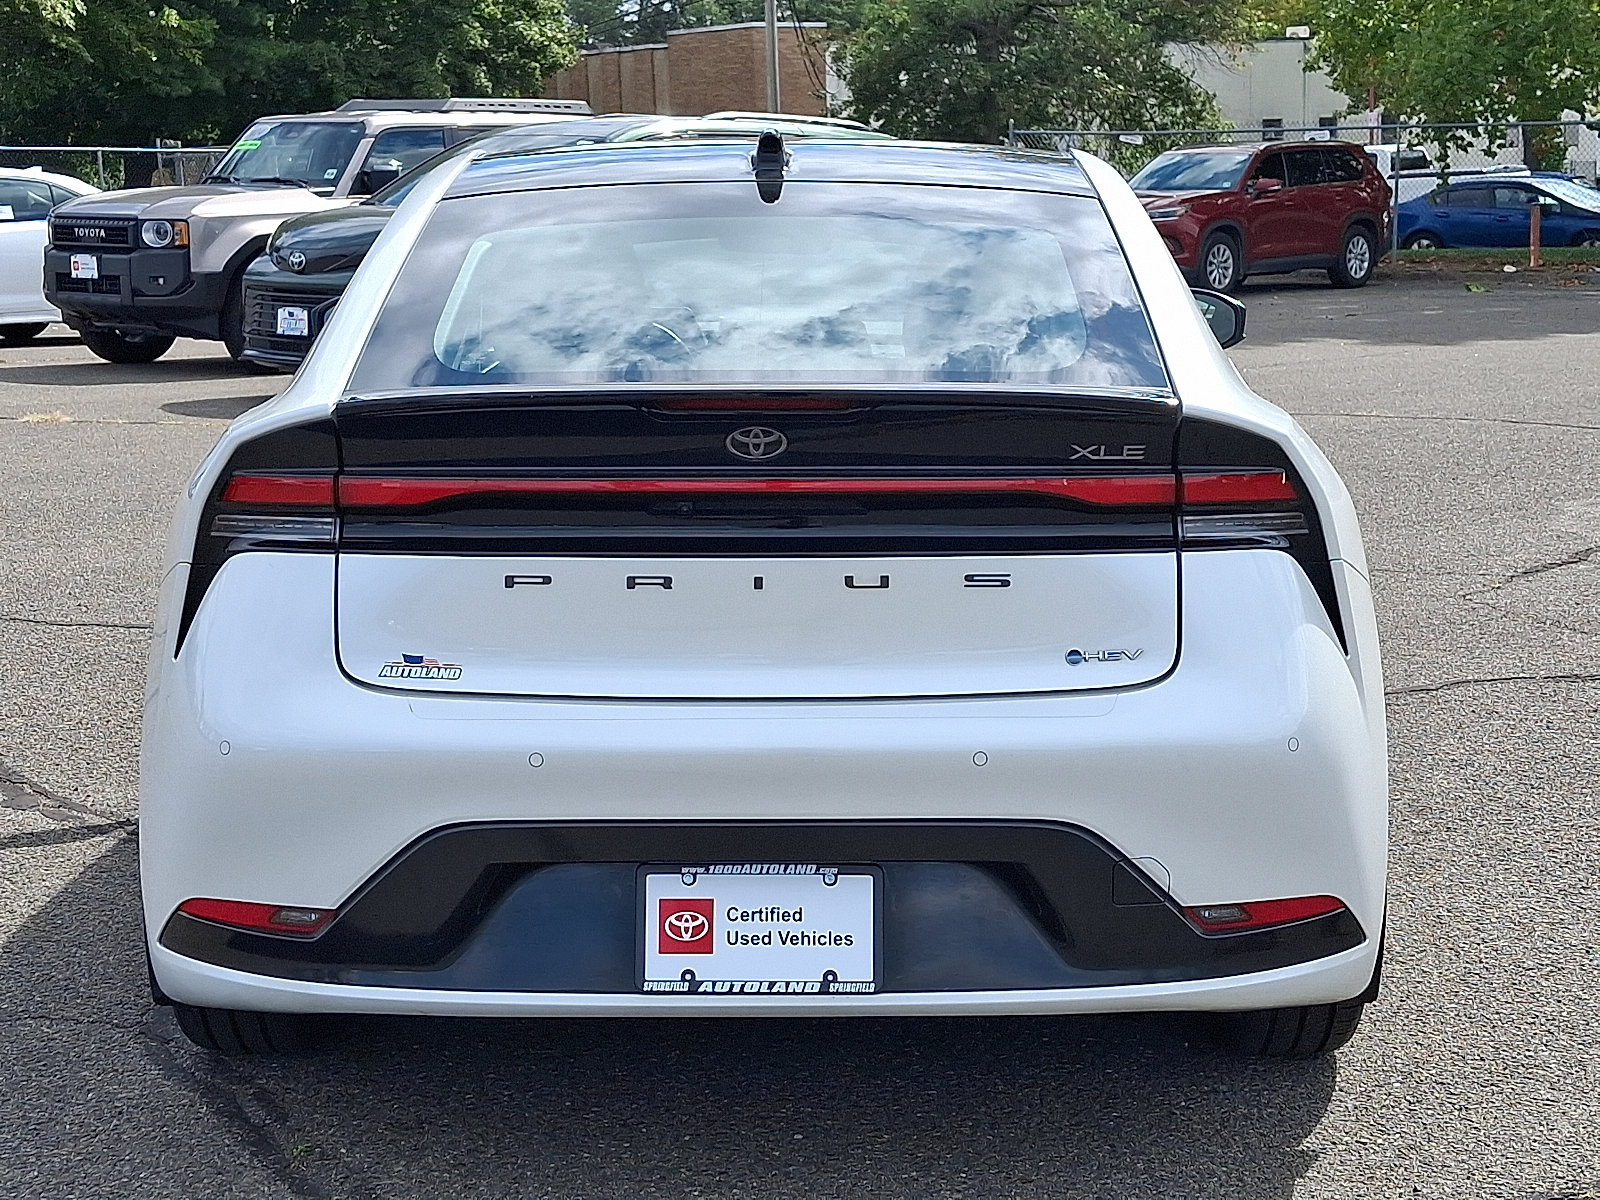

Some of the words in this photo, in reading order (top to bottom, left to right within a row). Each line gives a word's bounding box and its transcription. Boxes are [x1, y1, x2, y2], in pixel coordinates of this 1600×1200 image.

[74, 227, 106, 238] TOYOTA
[1069, 445, 1146, 460] XLE
[504, 574, 1012, 590] PRIUS
[1083, 648, 1144, 662] HEV
[379, 665, 462, 680] AUTOLAND
[726, 906, 803, 922] Certified
[726, 930, 772, 946] Used
[778, 930, 854, 946] Vehicles
[697, 981, 821, 993] AUTOLAND
